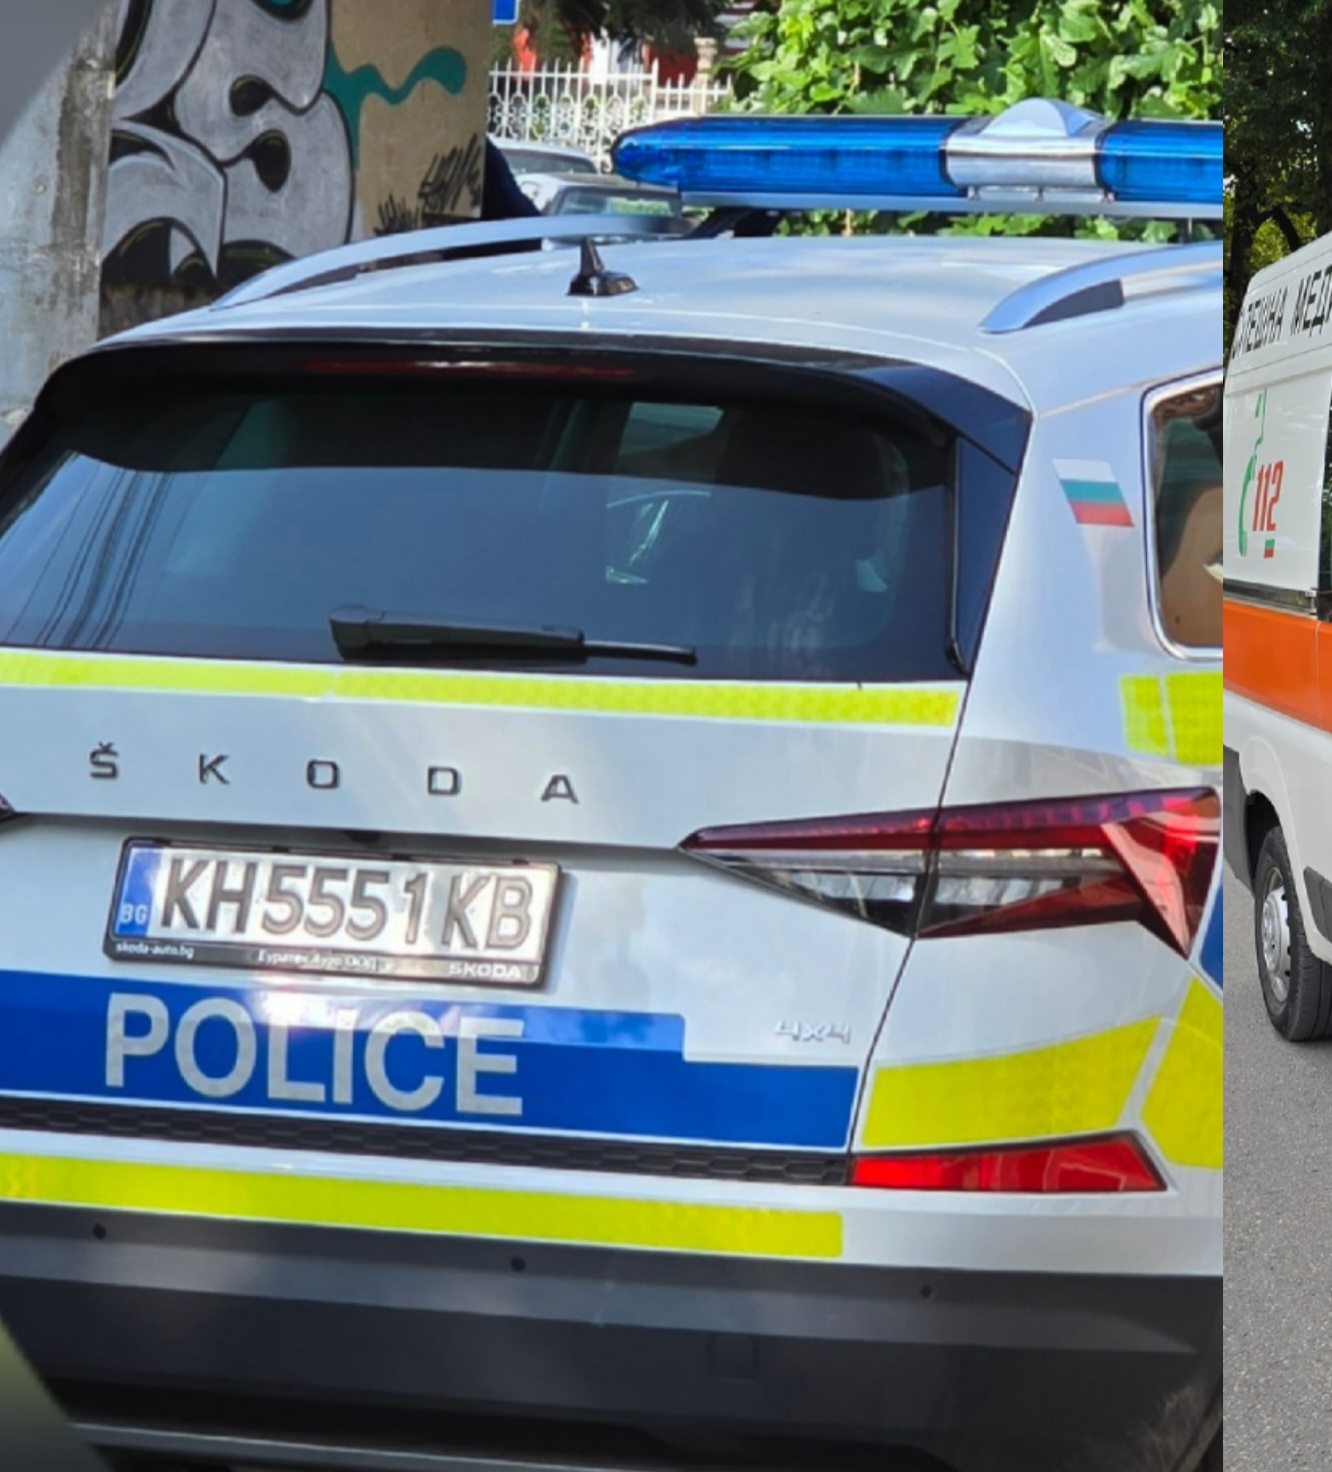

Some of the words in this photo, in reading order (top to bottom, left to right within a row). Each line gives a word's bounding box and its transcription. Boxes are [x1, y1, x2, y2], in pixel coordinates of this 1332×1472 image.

[1252, 460, 1284, 532] 112
[89, 742, 579, 805] ŠKODA
[119, 904, 148, 925] BG
[105, 993, 524, 1116] POLICE
